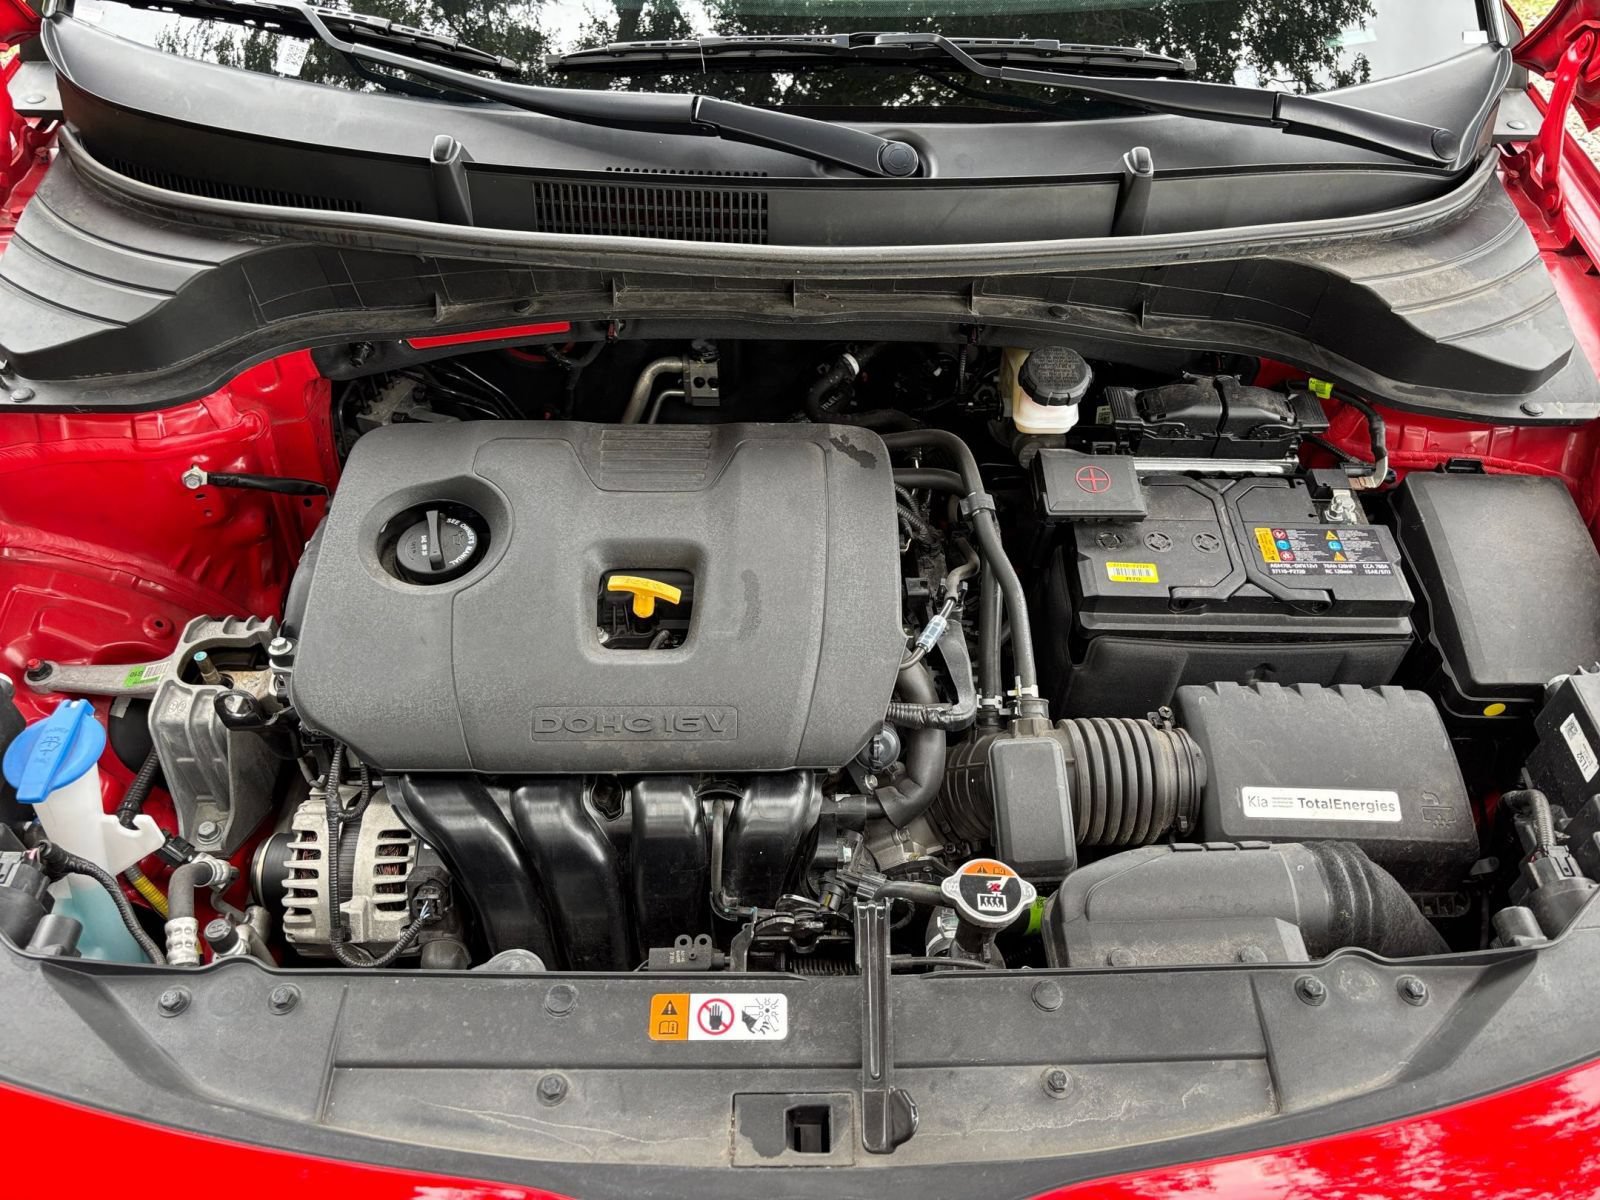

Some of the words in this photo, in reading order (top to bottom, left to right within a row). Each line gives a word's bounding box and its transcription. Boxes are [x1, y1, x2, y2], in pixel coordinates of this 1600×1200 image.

[446, 518, 460, 526] SEE
[449, 546, 473, 566] MANUAL
[534, 714, 655, 734] DOHC
[664, 714, 729, 733] 16V
[1247, 795, 1269, 808] Kia
[1297, 797, 1396, 813] TotalEnergies
